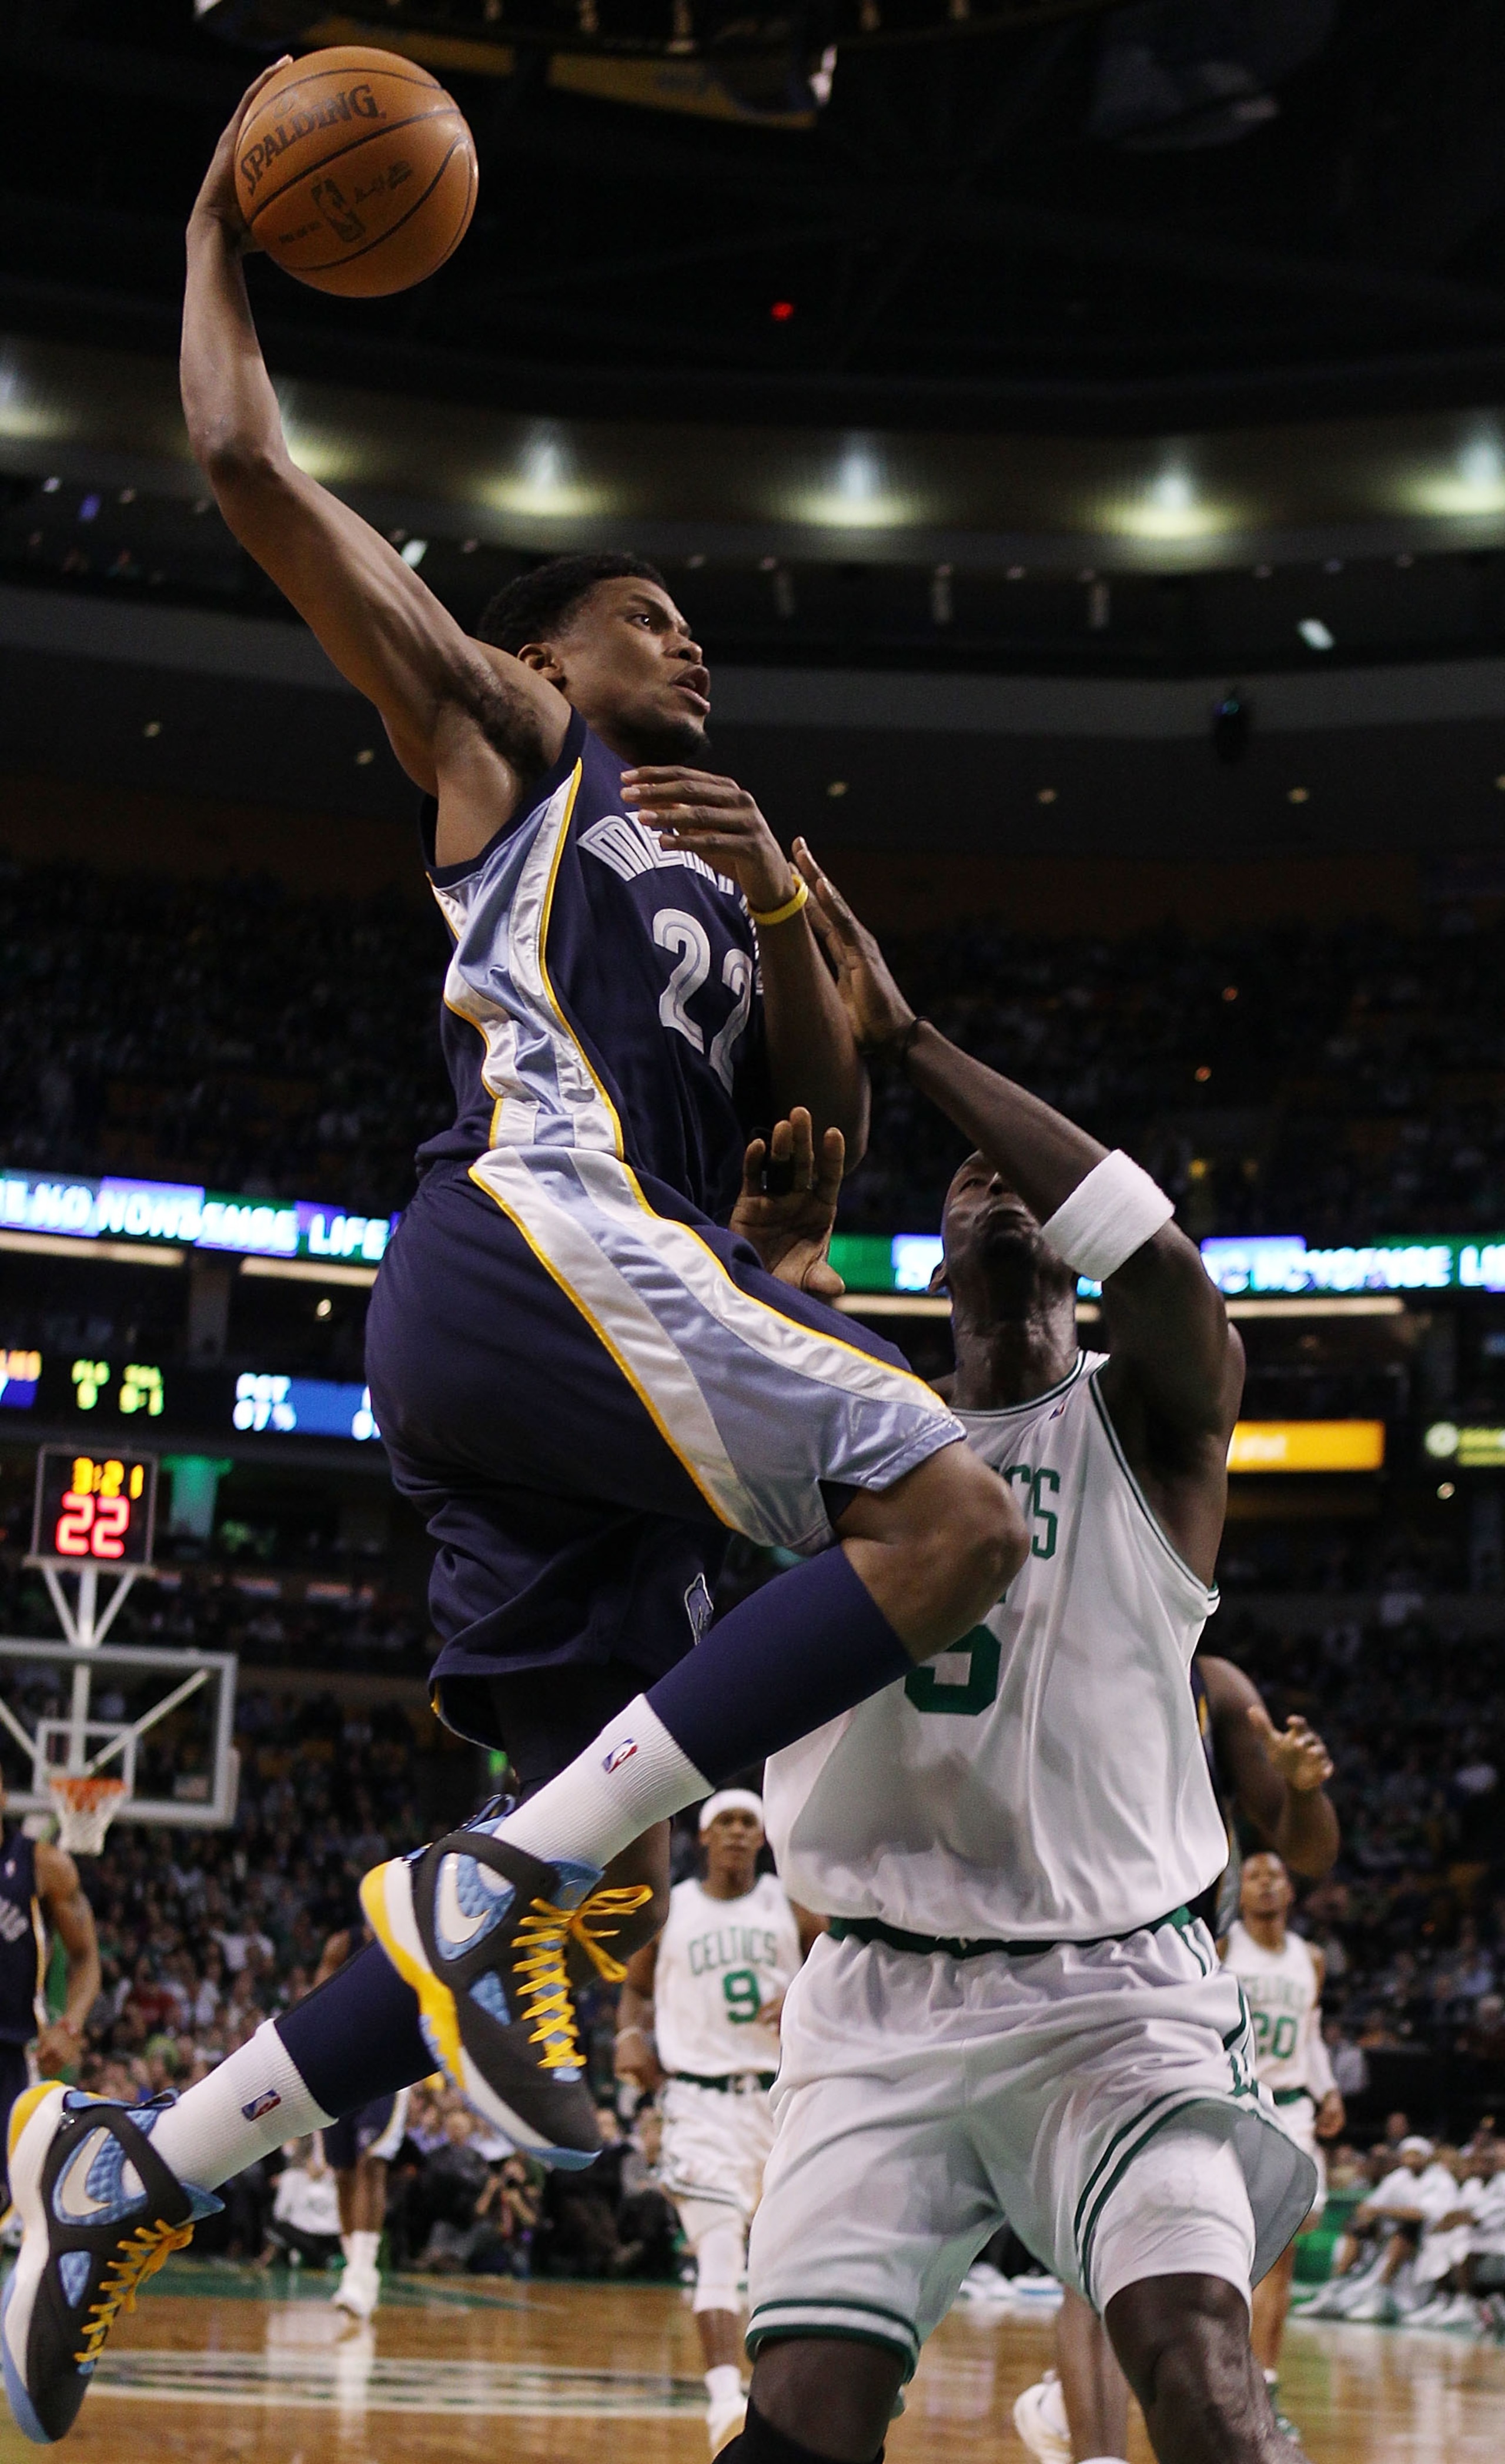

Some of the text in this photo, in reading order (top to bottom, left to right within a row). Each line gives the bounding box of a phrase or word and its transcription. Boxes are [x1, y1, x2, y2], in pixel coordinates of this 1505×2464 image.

[240, 84, 379, 196] SPALDING
[652, 908, 752, 1097] 22
[309, 1213, 388, 1260] LIFE
[56, 1491, 130, 1559] 22
[688, 1926, 778, 1976] CELTICS
[723, 1969, 761, 2024] 9
[1252, 2011, 1297, 2058] 20
